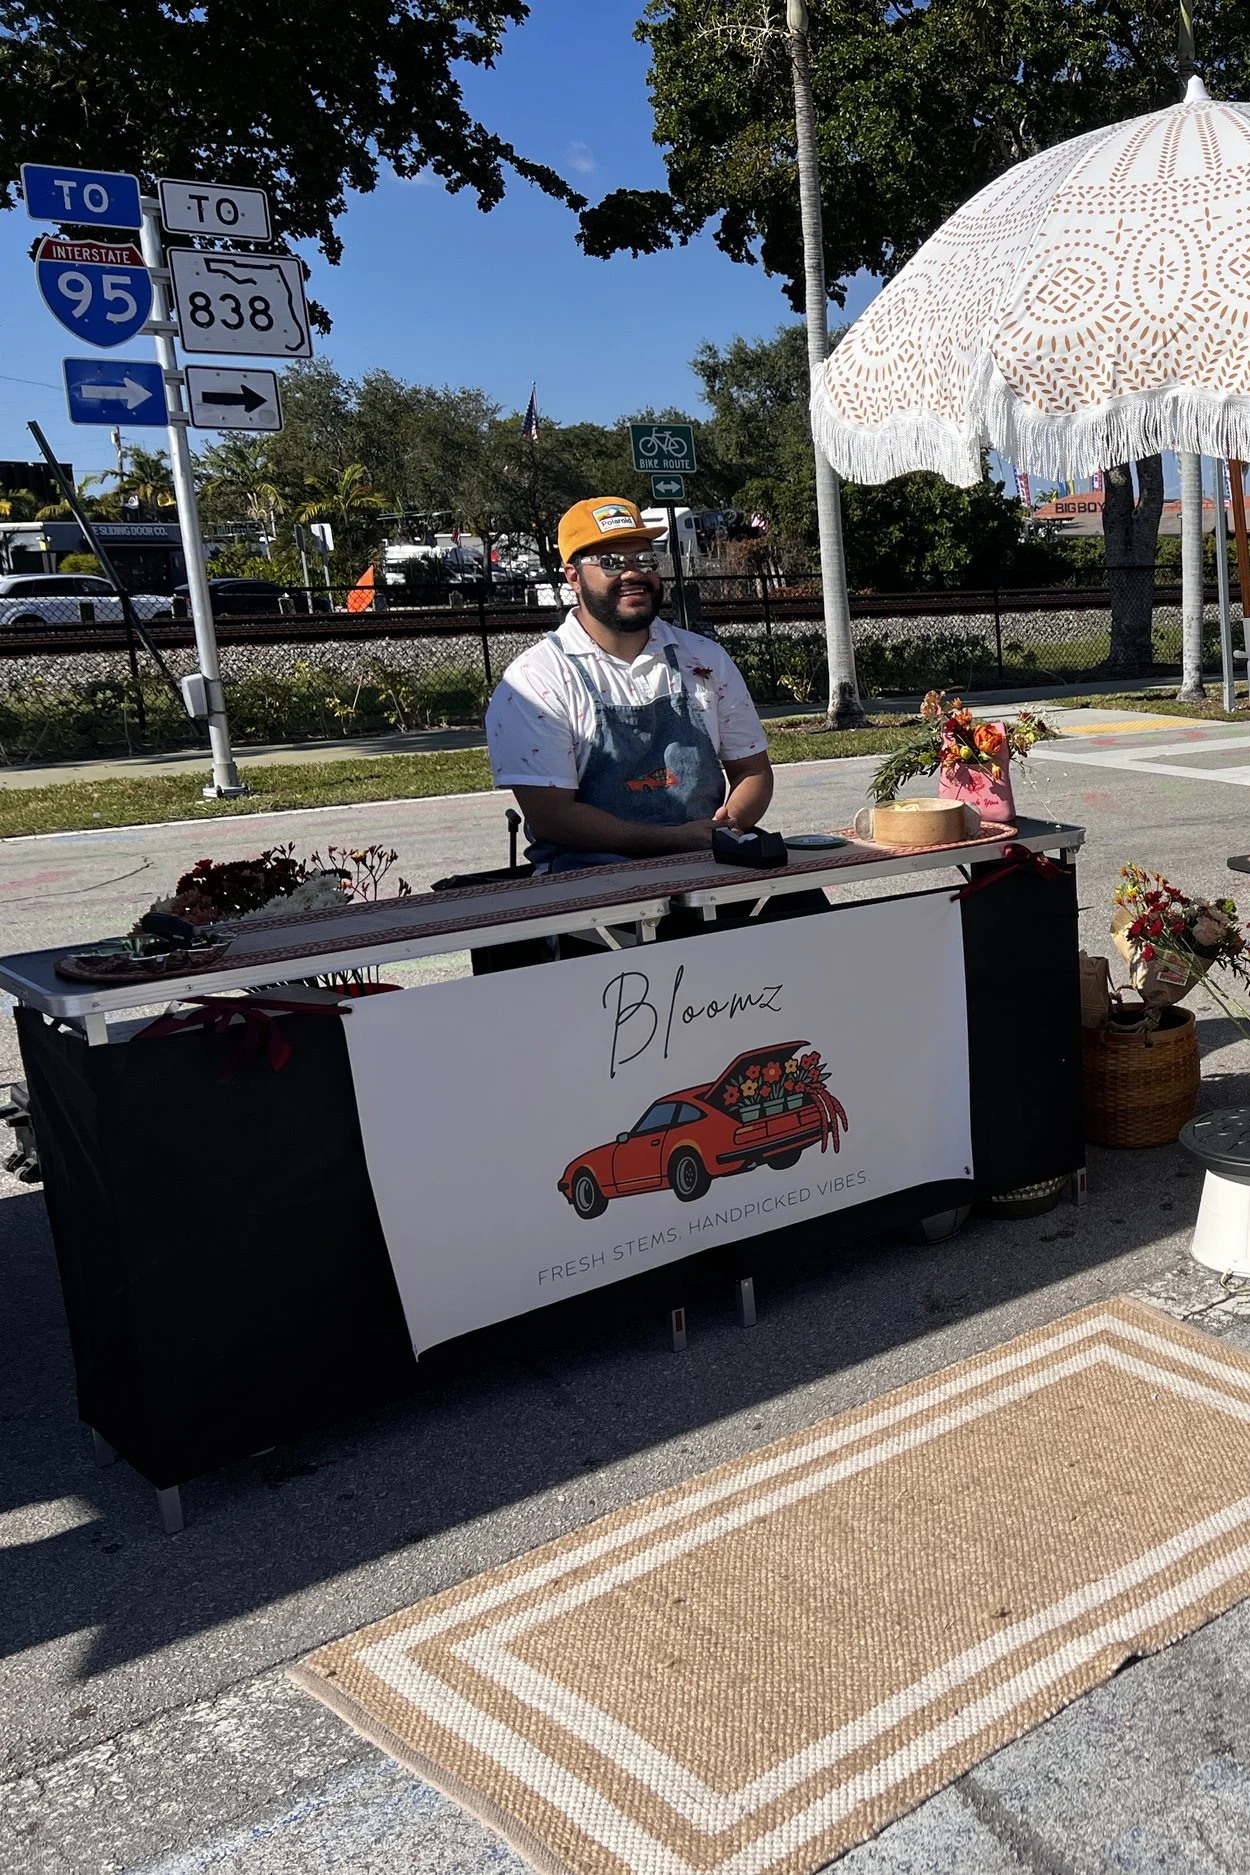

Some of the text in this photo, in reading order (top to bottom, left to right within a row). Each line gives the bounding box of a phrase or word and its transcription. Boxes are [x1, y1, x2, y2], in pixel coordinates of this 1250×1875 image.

[54, 179, 109, 213] TO
[188, 194, 239, 226] TO
[52, 245, 130, 264] INTERSTATE
[58, 271, 137, 323] 95
[189, 291, 274, 332] 838
[640, 458, 691, 469] BIKE ROUTE
[99, 526, 130, 535] SLIDING
[131, 526, 153, 536] DOOR
[154, 526, 168, 536] CO.
[601, 517, 632, 526] Polaroid
[602, 964, 784, 1079] Bloomz
[537, 1253, 605, 1286] FRESH
[688, 1187, 812, 1235] HANDPICKED
[816, 1170, 872, 1195] VIBES.
